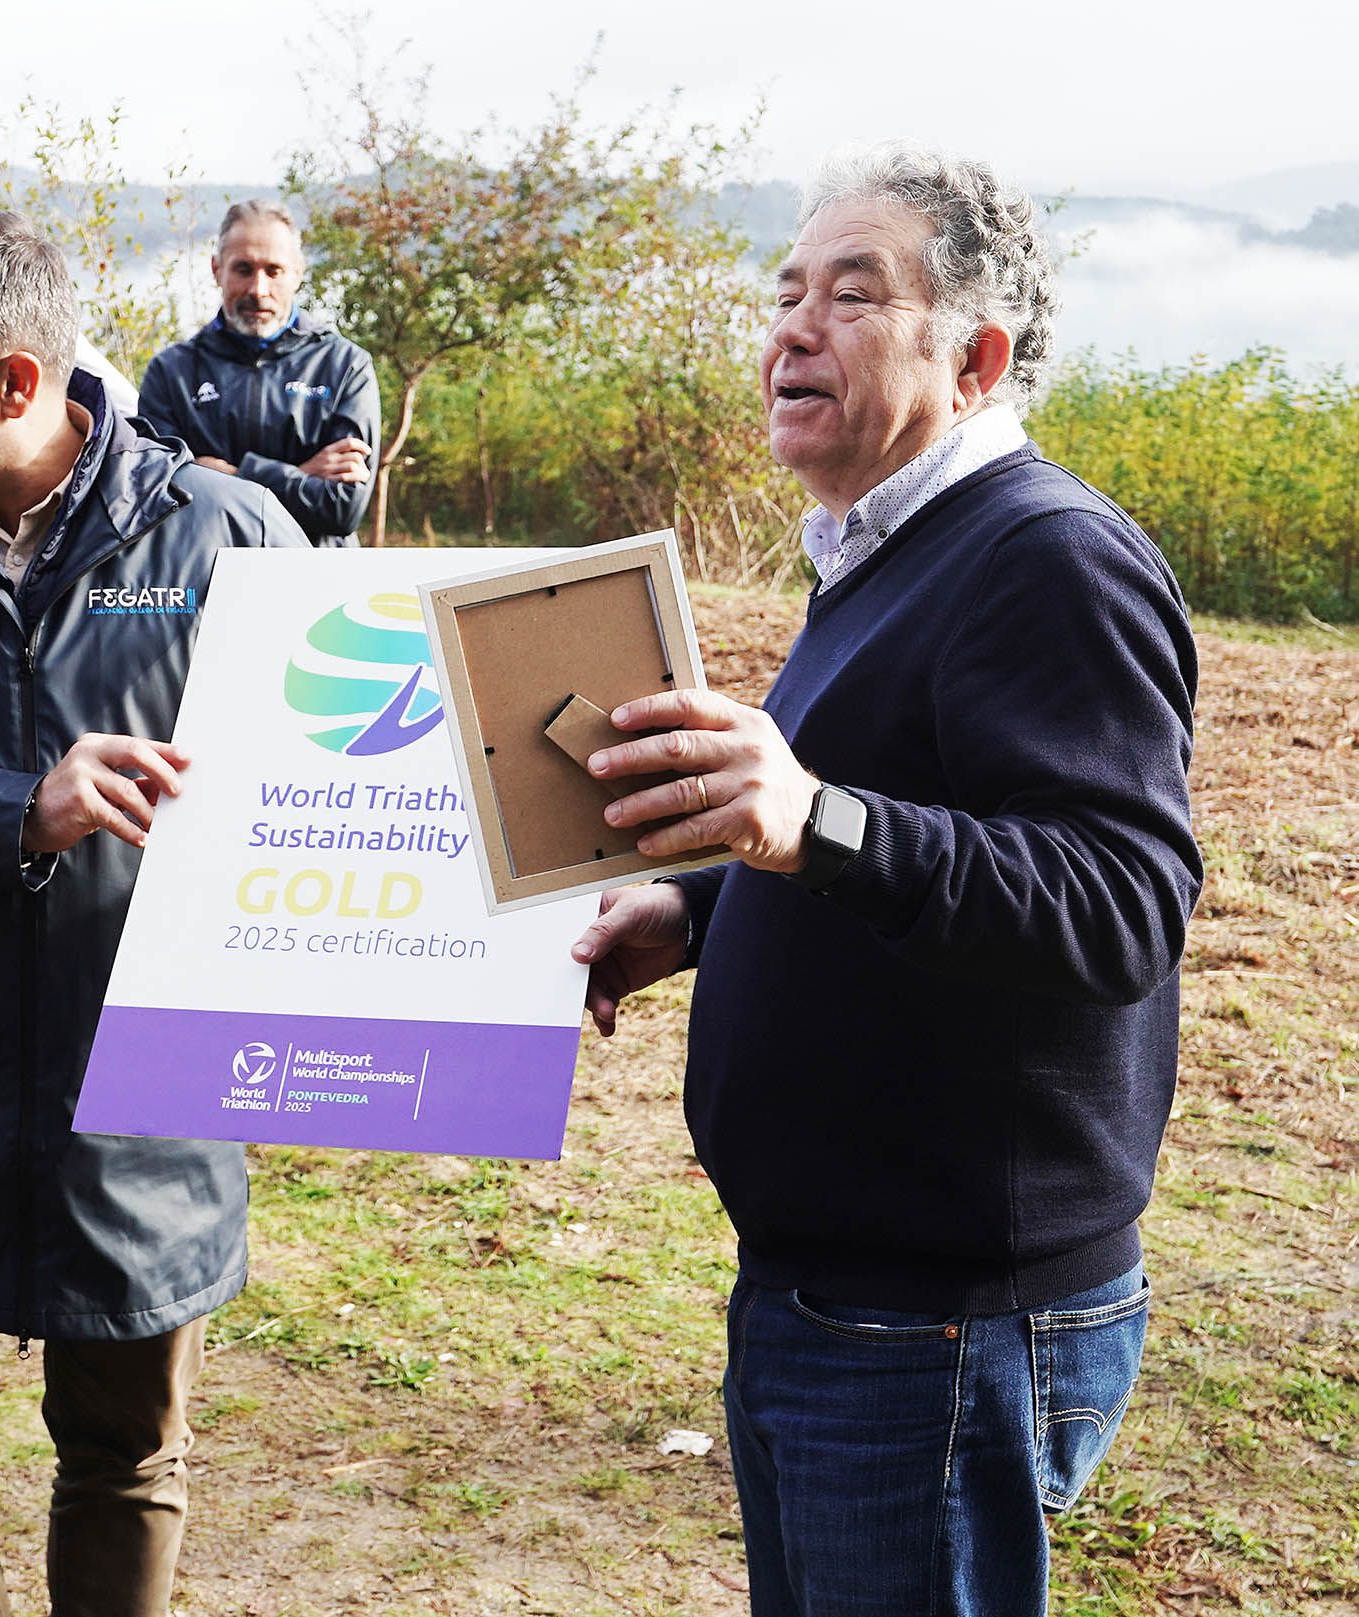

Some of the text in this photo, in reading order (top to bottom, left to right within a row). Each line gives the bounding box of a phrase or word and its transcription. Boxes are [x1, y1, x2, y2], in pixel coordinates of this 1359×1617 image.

[260, 782, 356, 810] World
[248, 822, 470, 859] Sustainability
[235, 867, 424, 920] GOLD
[224, 925, 487, 959] 2025 certification
[294, 1049, 374, 1068] Multisport
[292, 1066, 416, 1086] World Championships
[230, 1086, 267, 1100] World
[287, 1090, 370, 1105] PONTEVEDRA
[220, 1096, 271, 1112] Triathlon
[284, 1101, 313, 1114] 2025
